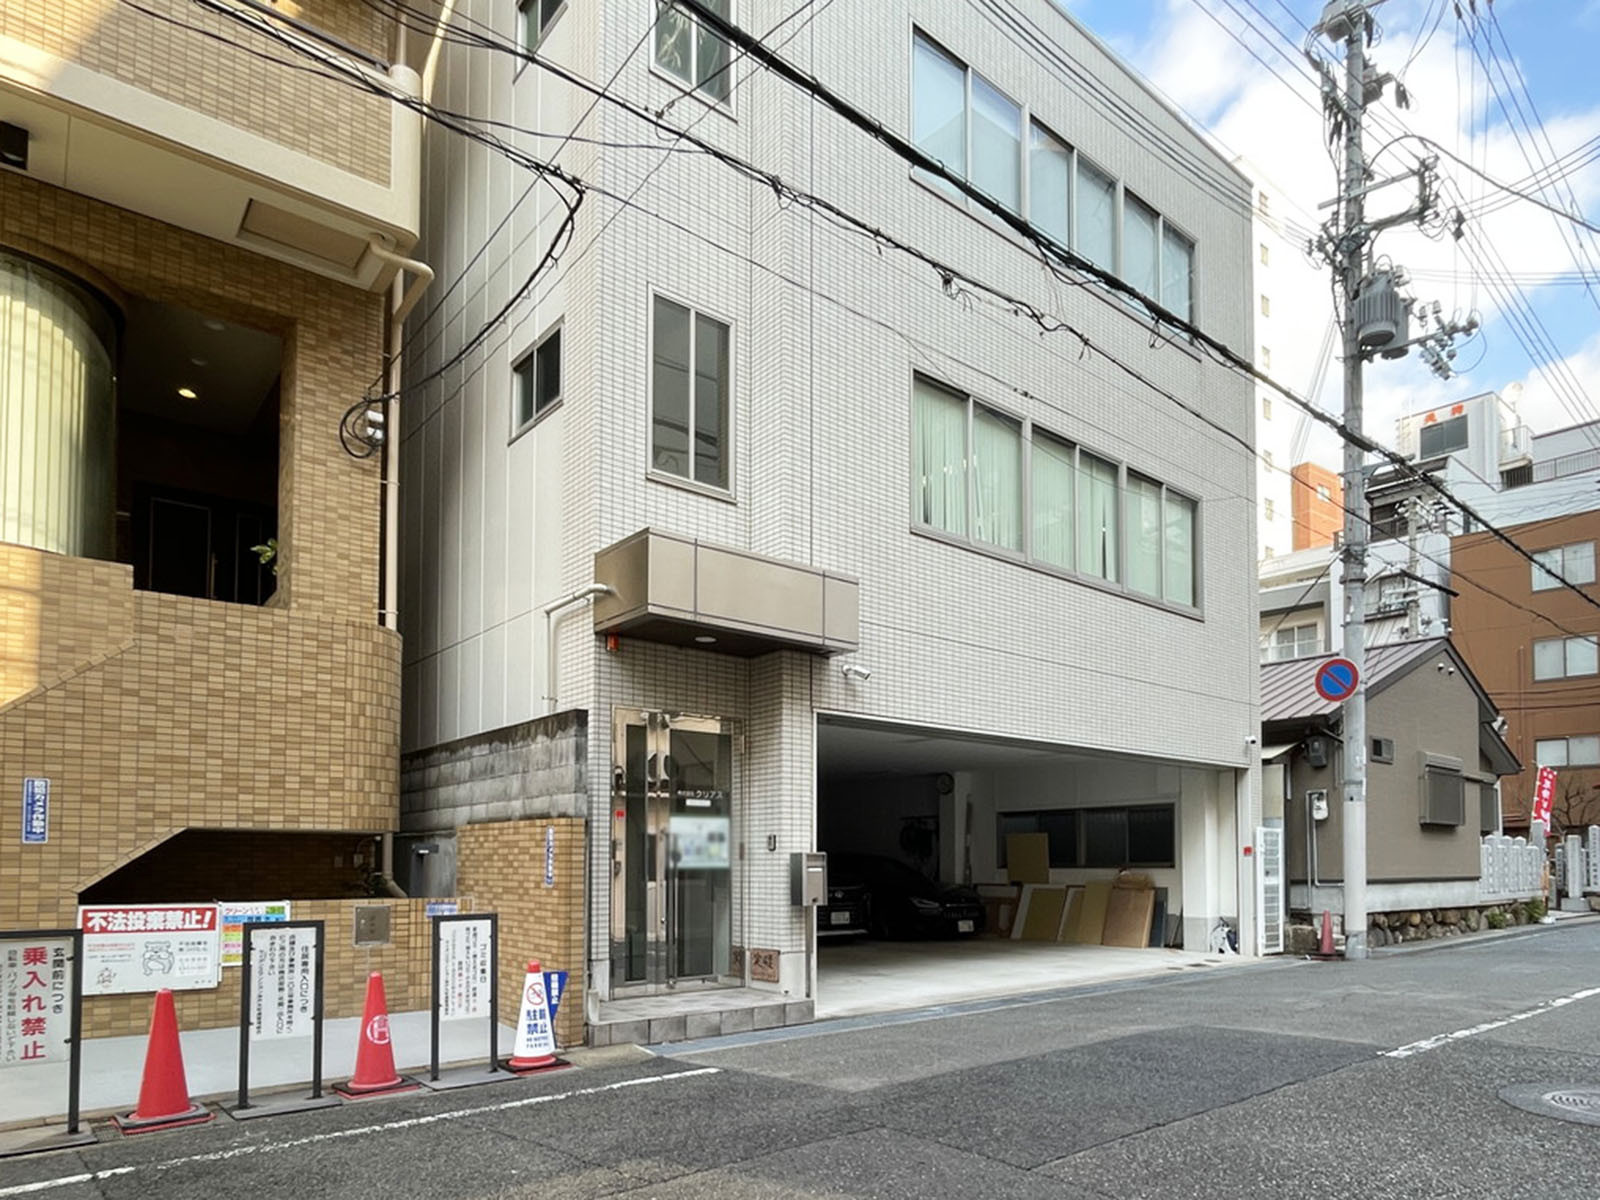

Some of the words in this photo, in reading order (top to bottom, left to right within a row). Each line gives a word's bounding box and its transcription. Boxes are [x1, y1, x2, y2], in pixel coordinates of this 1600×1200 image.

[86, 910, 213, 931] 不法投棄禁止!
[20, 946, 47, 1060] 乗入れ禁止
[52, 947, 65, 1014] 玄関前につき
